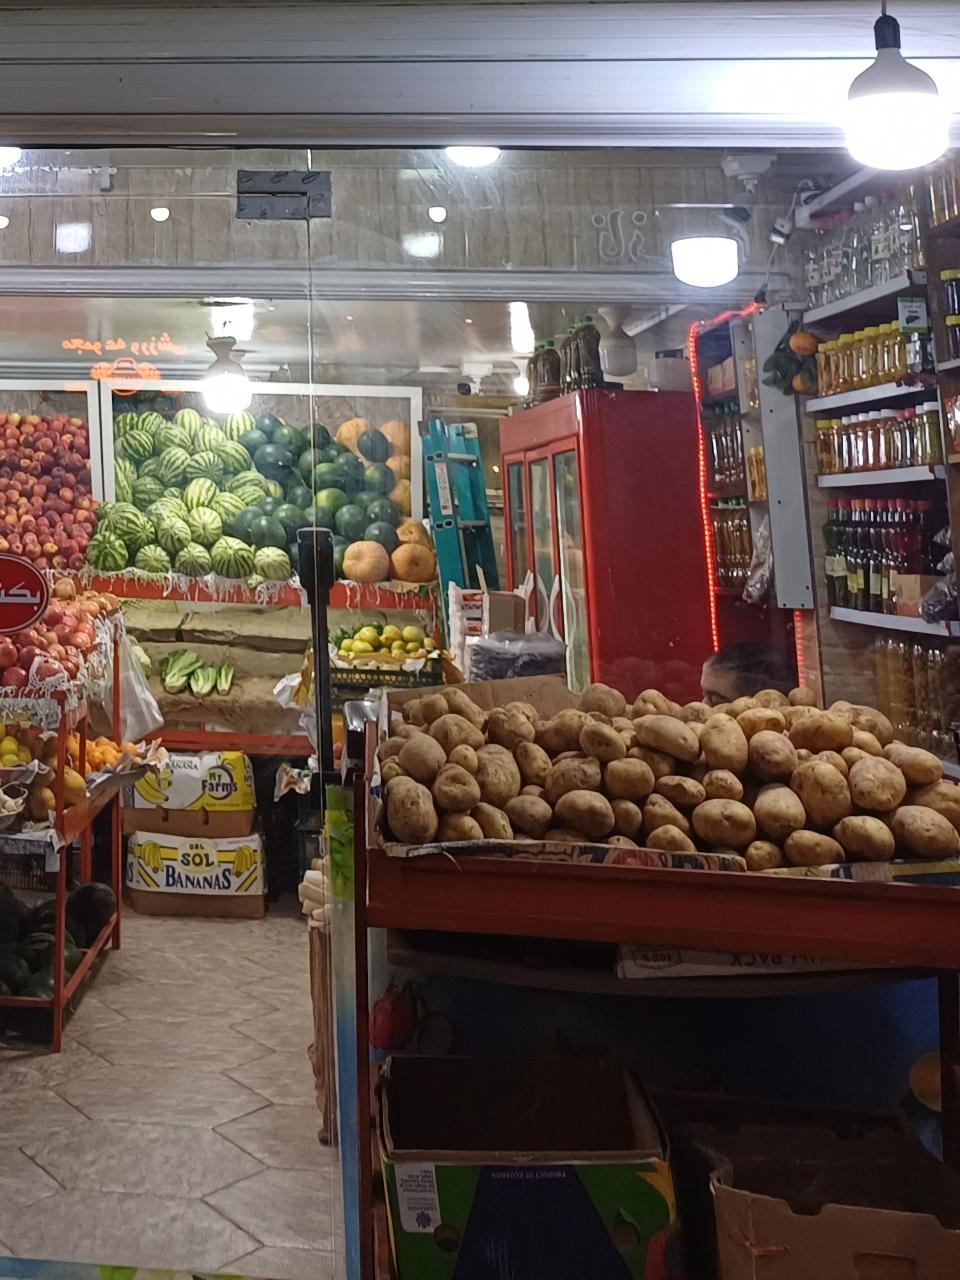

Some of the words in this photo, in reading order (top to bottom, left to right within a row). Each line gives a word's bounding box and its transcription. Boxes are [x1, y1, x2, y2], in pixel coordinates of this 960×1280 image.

[201, 780, 238, 793] Farms
[180, 852, 215, 867] SOL
[164, 864, 232, 890] BANANAS
